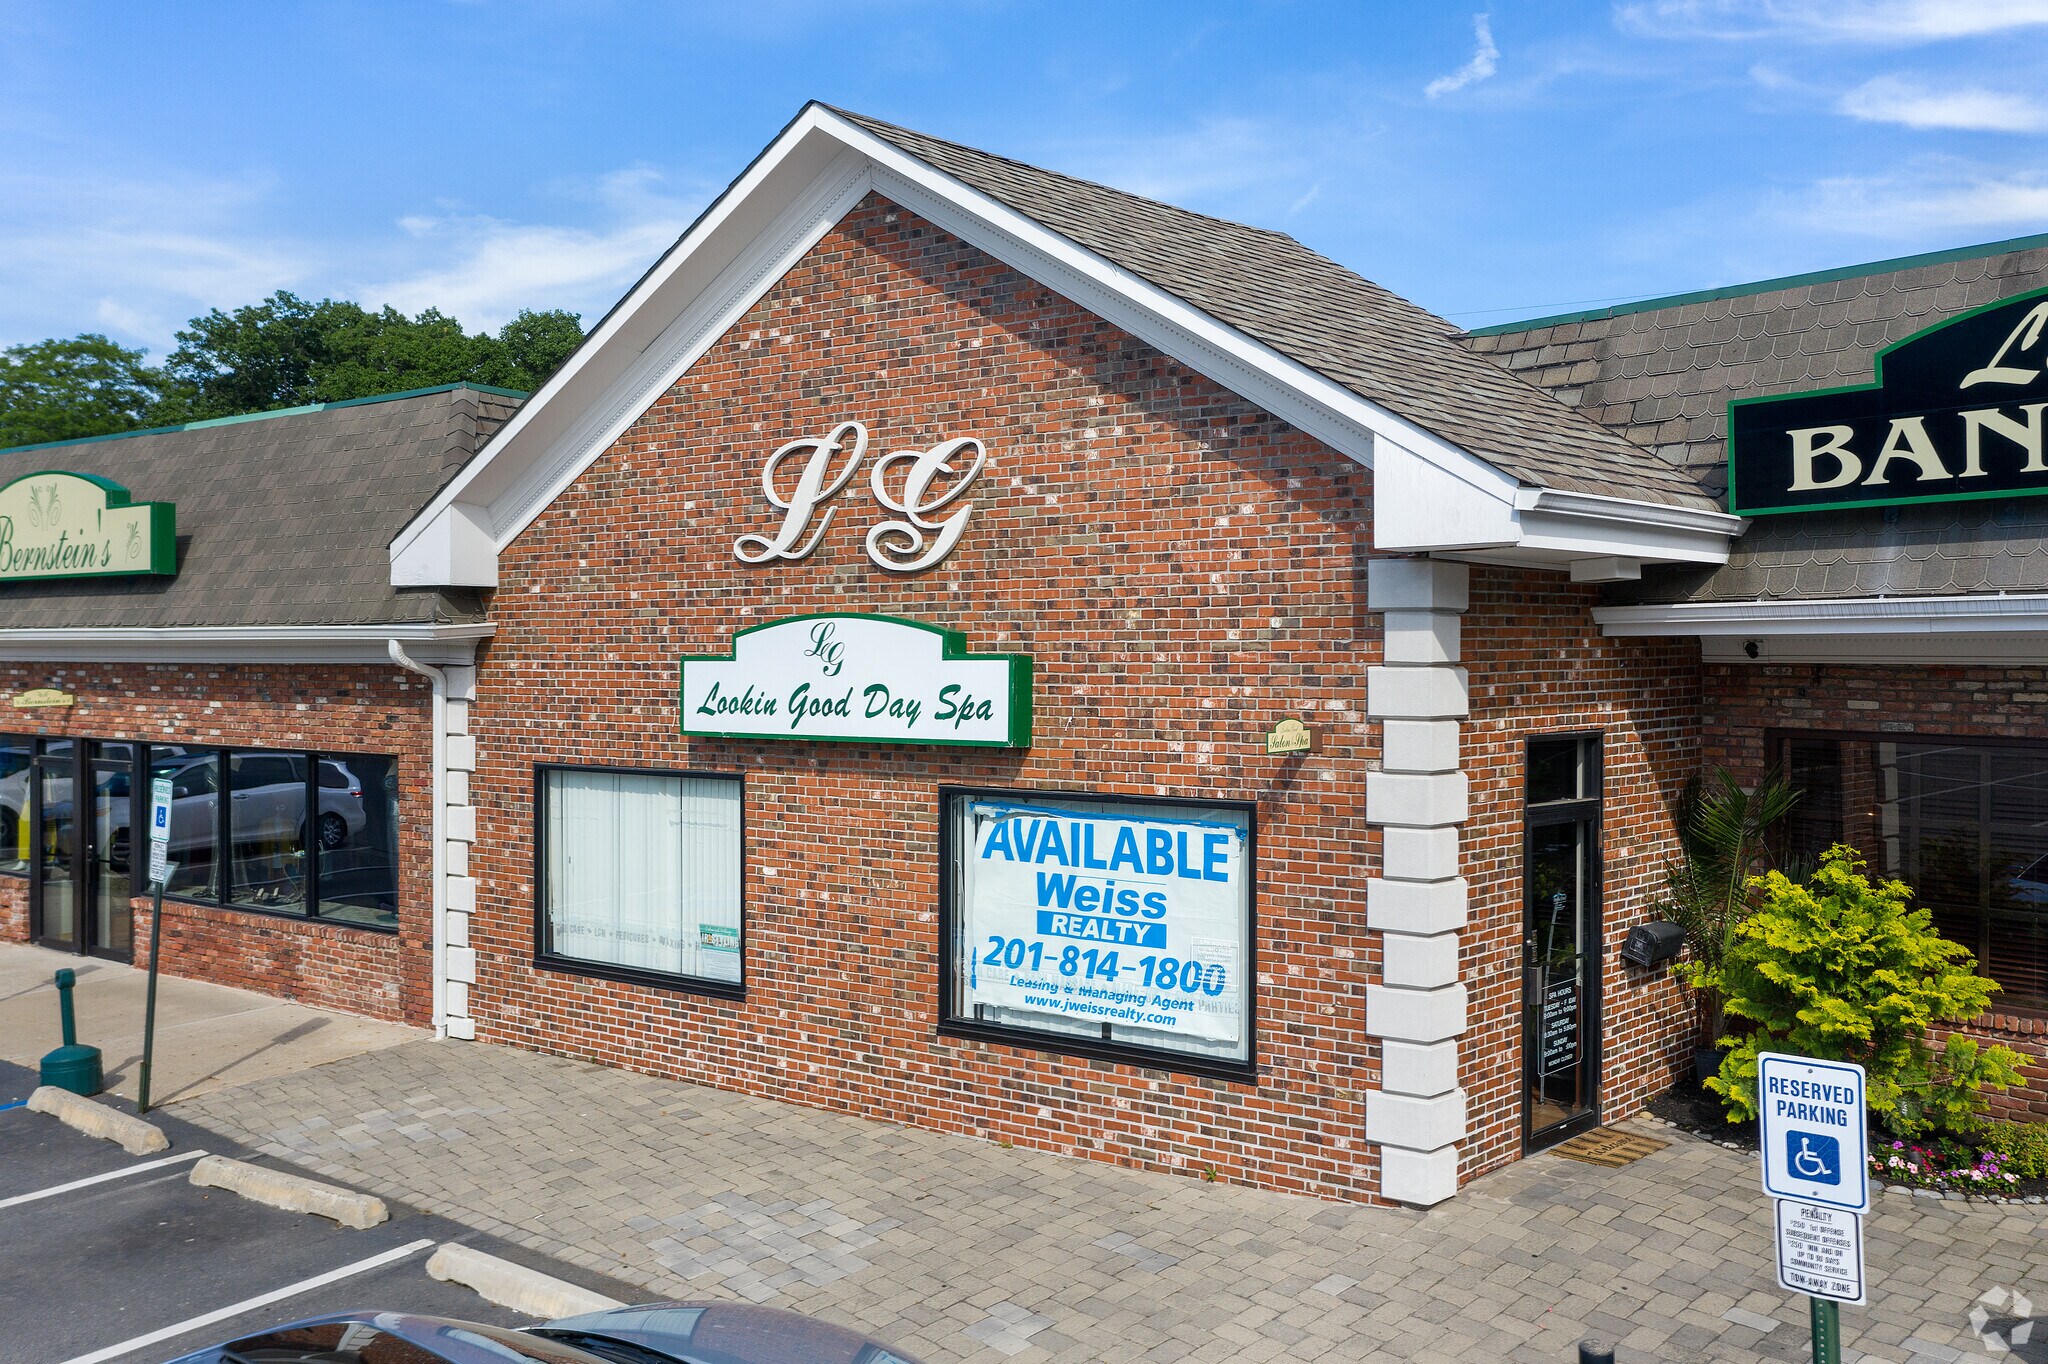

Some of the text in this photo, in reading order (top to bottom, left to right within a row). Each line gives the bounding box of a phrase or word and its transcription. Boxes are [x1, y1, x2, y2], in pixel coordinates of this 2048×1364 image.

[1959, 301, 2048, 390] L
[0, 508, 112, 572] Bernstein's
[697, 681, 994, 729] Lookin Good Day Spa
[982, 818, 1229, 882] AVAILABLE
[1036, 872, 1167, 919] Weiss
[1051, 914, 1151, 943] REALTY
[983, 936, 1225, 996] 201-814-1800
[1010, 975, 1058, 995] Leasing
[1064, 984, 1074, 994] &
[1079, 986, 1147, 1007] Managing
[1152, 994, 1194, 1011] Agent
[1549, 986, 1571, 999] SPA HOURS
[1024, 993, 1177, 1026] www.jweissrealty.com
[1769, 1077, 1854, 1105] RESERVED
[1777, 1099, 1848, 1127] PARKING
[1801, 1208, 1832, 1222] PENALTY
[1785, 1228, 1851, 1247] SUBSEQUENT OFFENSES
[1820, 1226, 1844, 1236] OFFENSE
[1790, 1258, 1848, 1275] COMMUNITY SERVICE
[1790, 1272, 1851, 1293] TOW-AWAY ZONE
